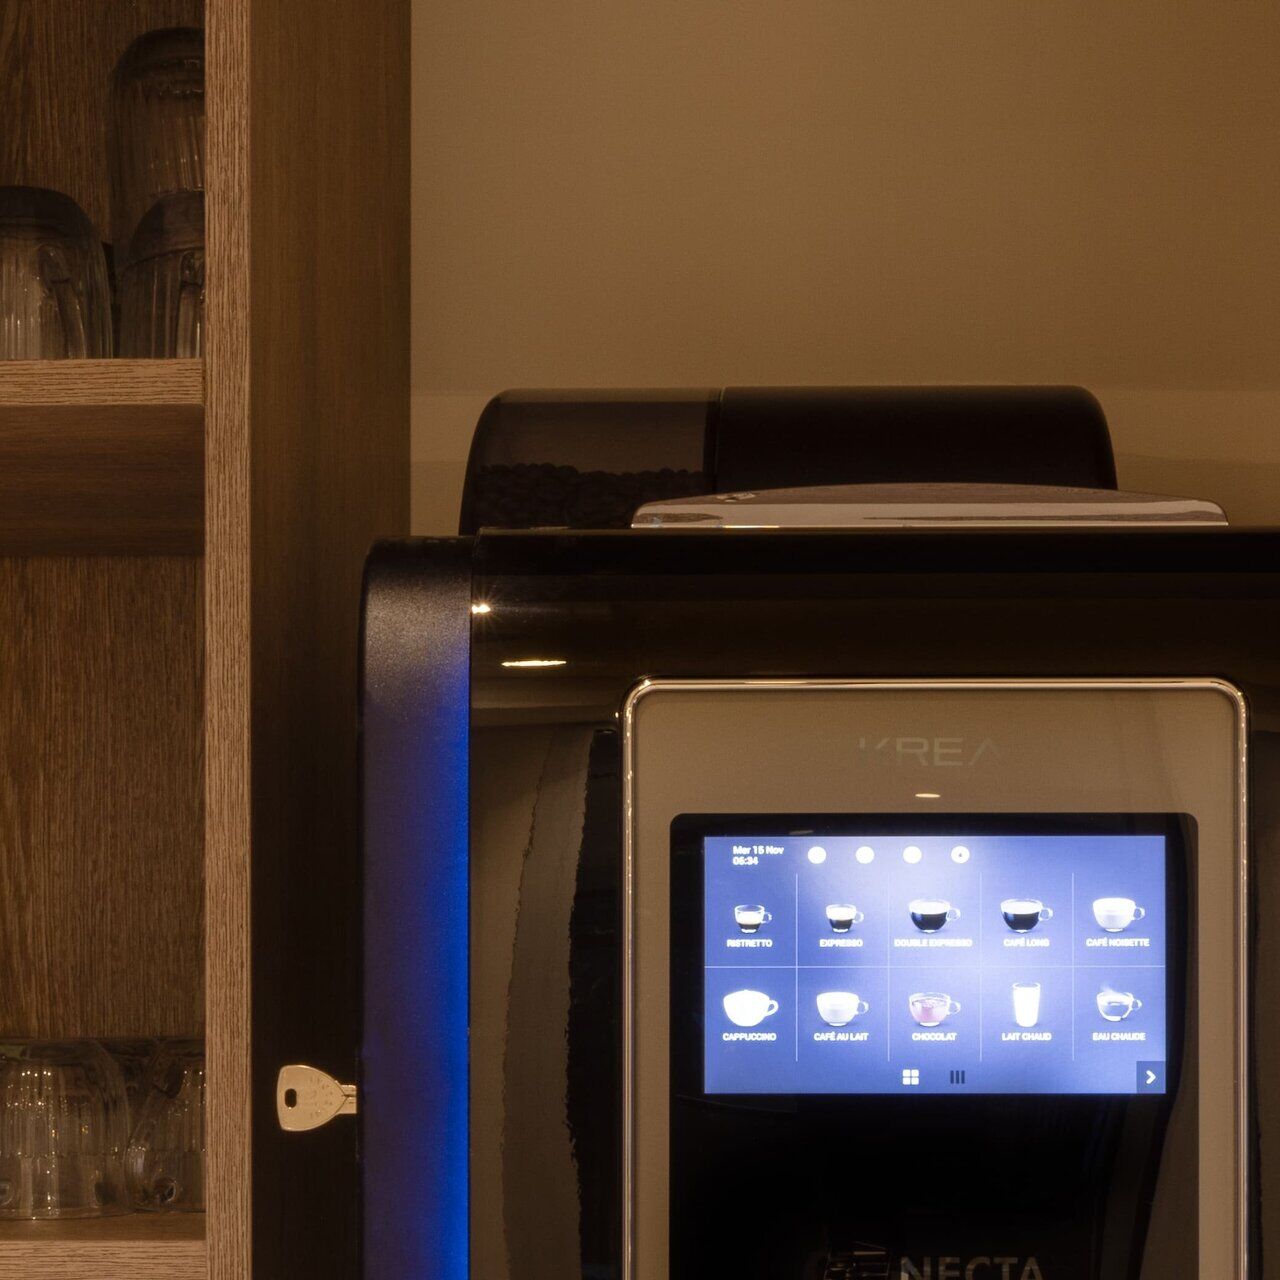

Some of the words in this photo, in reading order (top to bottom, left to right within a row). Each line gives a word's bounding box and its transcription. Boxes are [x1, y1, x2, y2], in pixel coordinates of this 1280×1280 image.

[753, 846, 764, 855] 15
[765, 846, 784, 855] Nov
[727, 939, 773, 948] RISTRETTO
[819, 939, 863, 948] EXPRESSO
[894, 939, 928, 948] DOUBLE
[929, 939, 973, 948] EXPRESSO
[1003, 937, 1025, 947] CAFÉ
[1026, 938, 1050, 947] LONG
[1086, 937, 1108, 947] CAFÉ
[1109, 938, 1150, 947] NOISETTE
[723, 1032, 776, 1041] CAPPUCCINO
[814, 1031, 835, 1041] CAFÉ
[836, 1032, 849, 1041] AU
[849, 1032, 869, 1041] LAIT
[911, 1032, 957, 1041] CHOCOLAT
[1002, 1032, 1022, 1041] LAIT
[1022, 1032, 1051, 1041] CHAUD
[1092, 1032, 1110, 1041] EAU
[1111, 1032, 1146, 1041] CHAUDE
